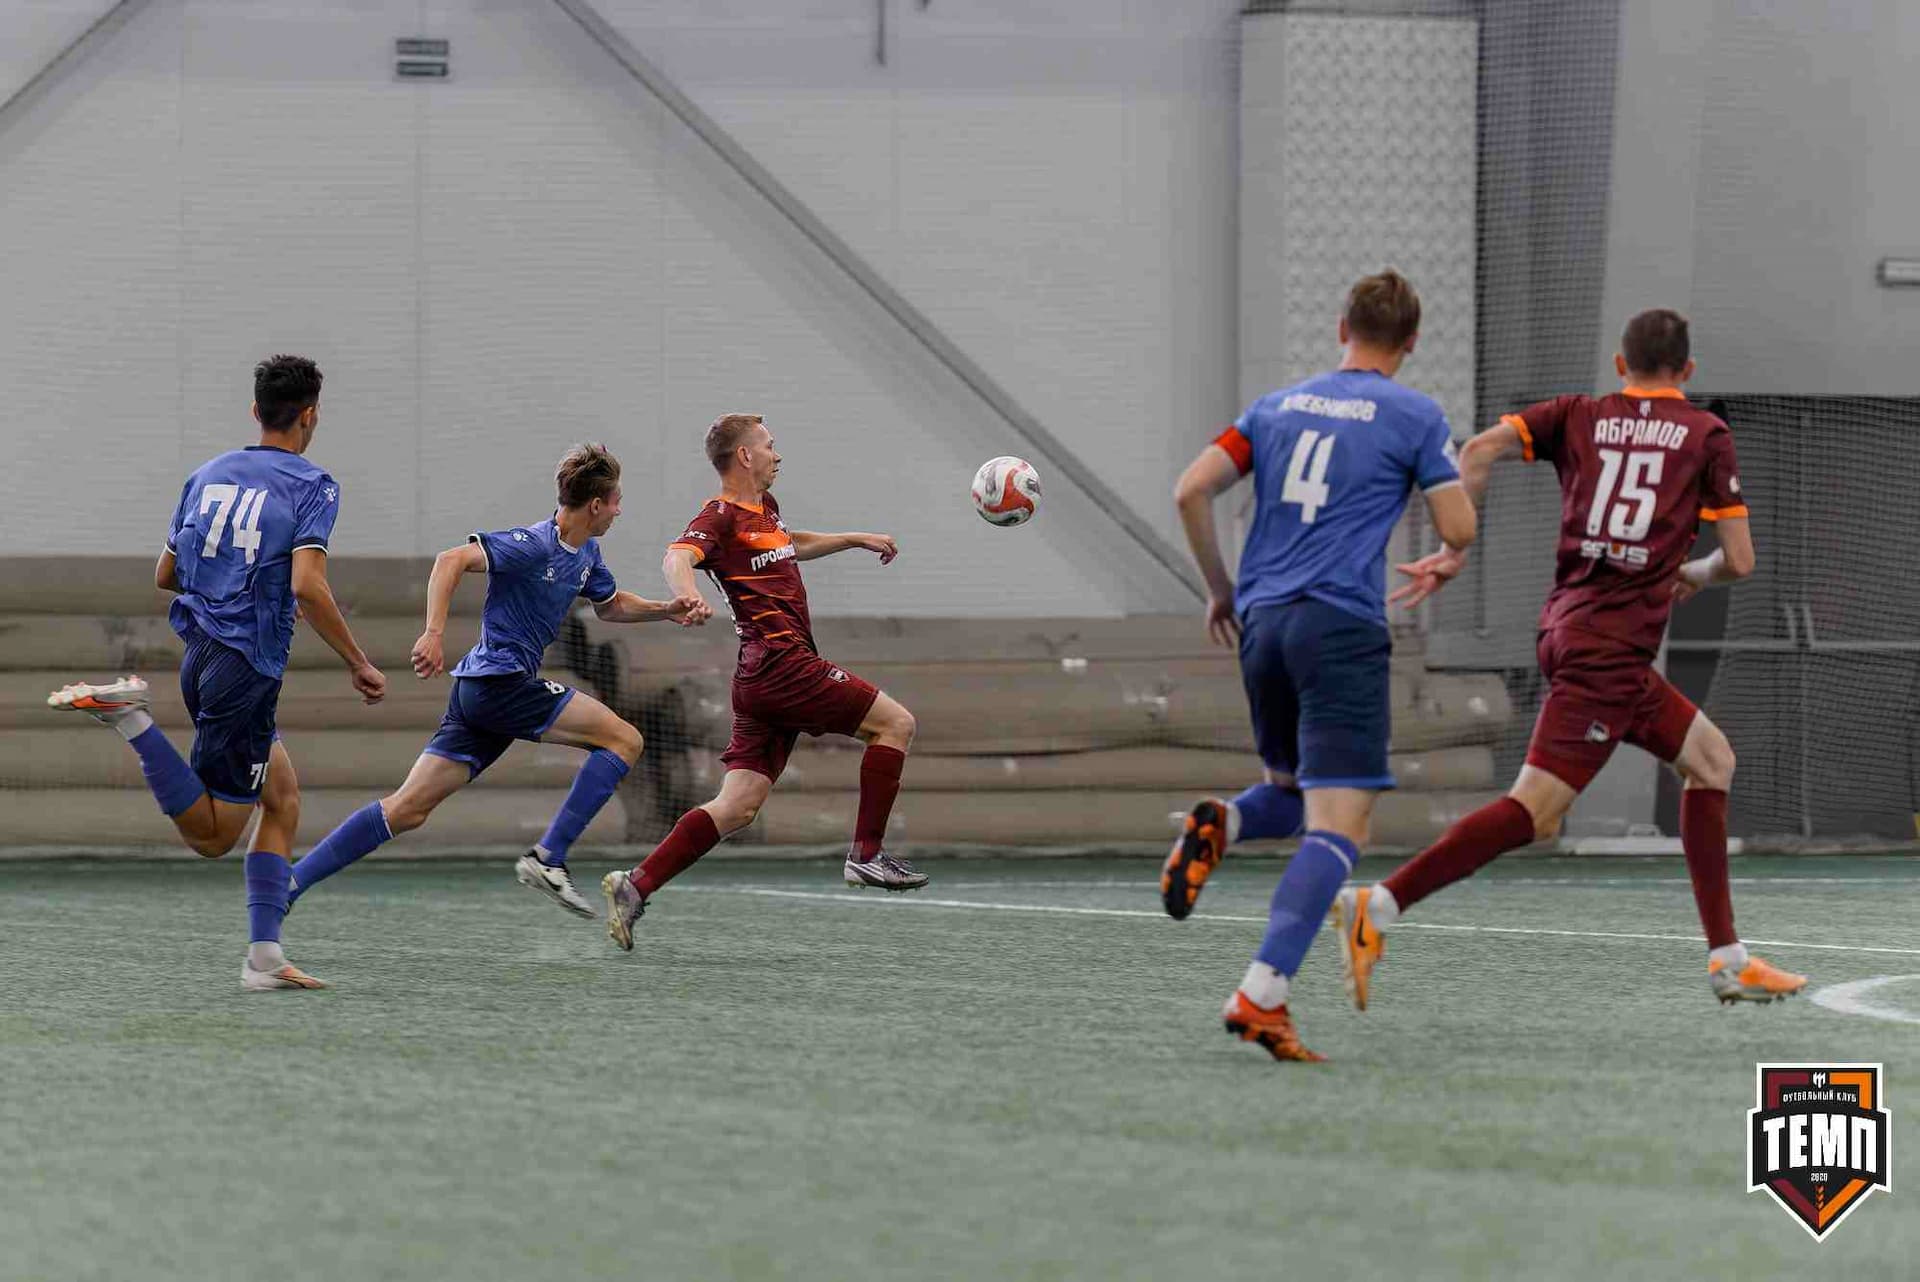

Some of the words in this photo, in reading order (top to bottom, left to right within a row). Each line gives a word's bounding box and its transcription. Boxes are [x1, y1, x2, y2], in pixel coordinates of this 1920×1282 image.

[1281, 429, 1337, 525] 4
[1594, 417, 1689, 450] АБРАМОВ
[200, 483, 269, 565] 74
[1586, 449, 1665, 542] 15
